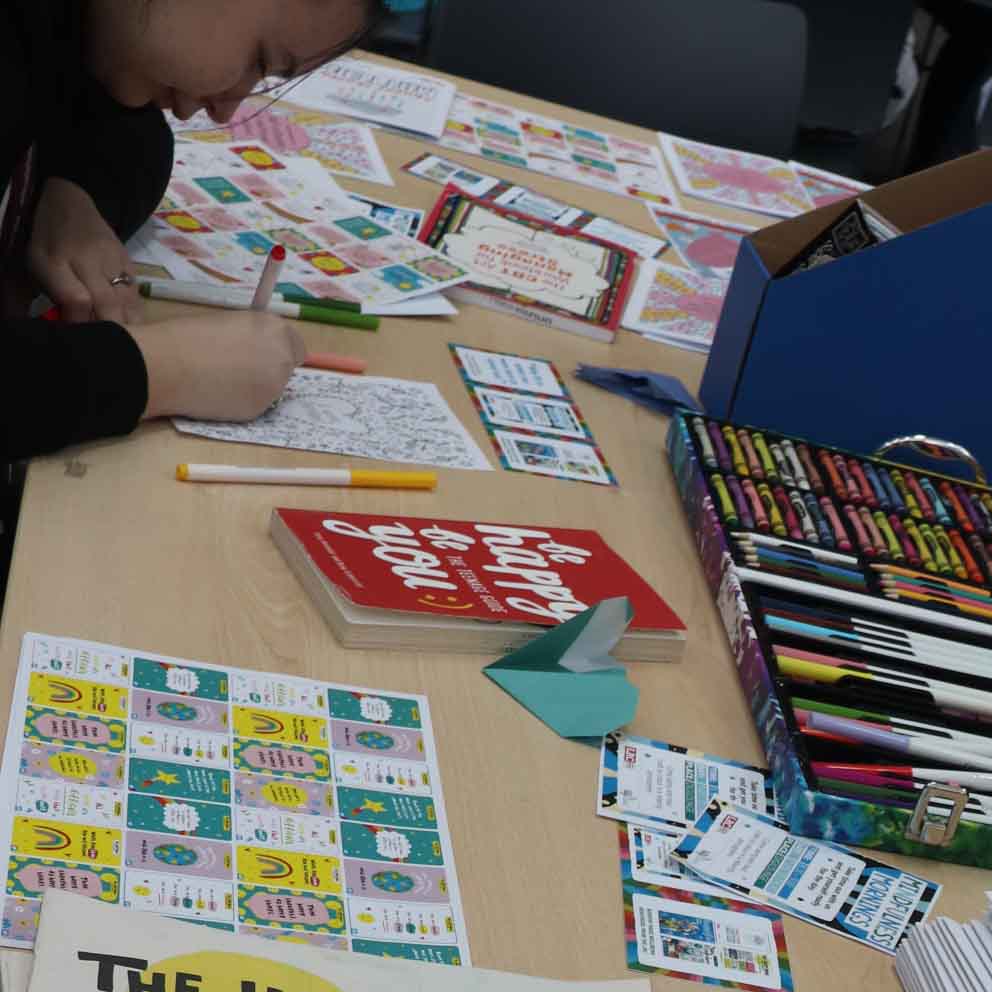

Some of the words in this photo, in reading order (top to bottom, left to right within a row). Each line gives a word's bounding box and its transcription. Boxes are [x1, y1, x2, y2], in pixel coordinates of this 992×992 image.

[323, 520, 457, 592] you
[420, 525, 476, 552] be
[538, 537, 592, 566] be
[475, 524, 588, 623] happy
[848, 872, 894, 928] MORNINGS
[869, 875, 920, 947] MINDFULNESS
